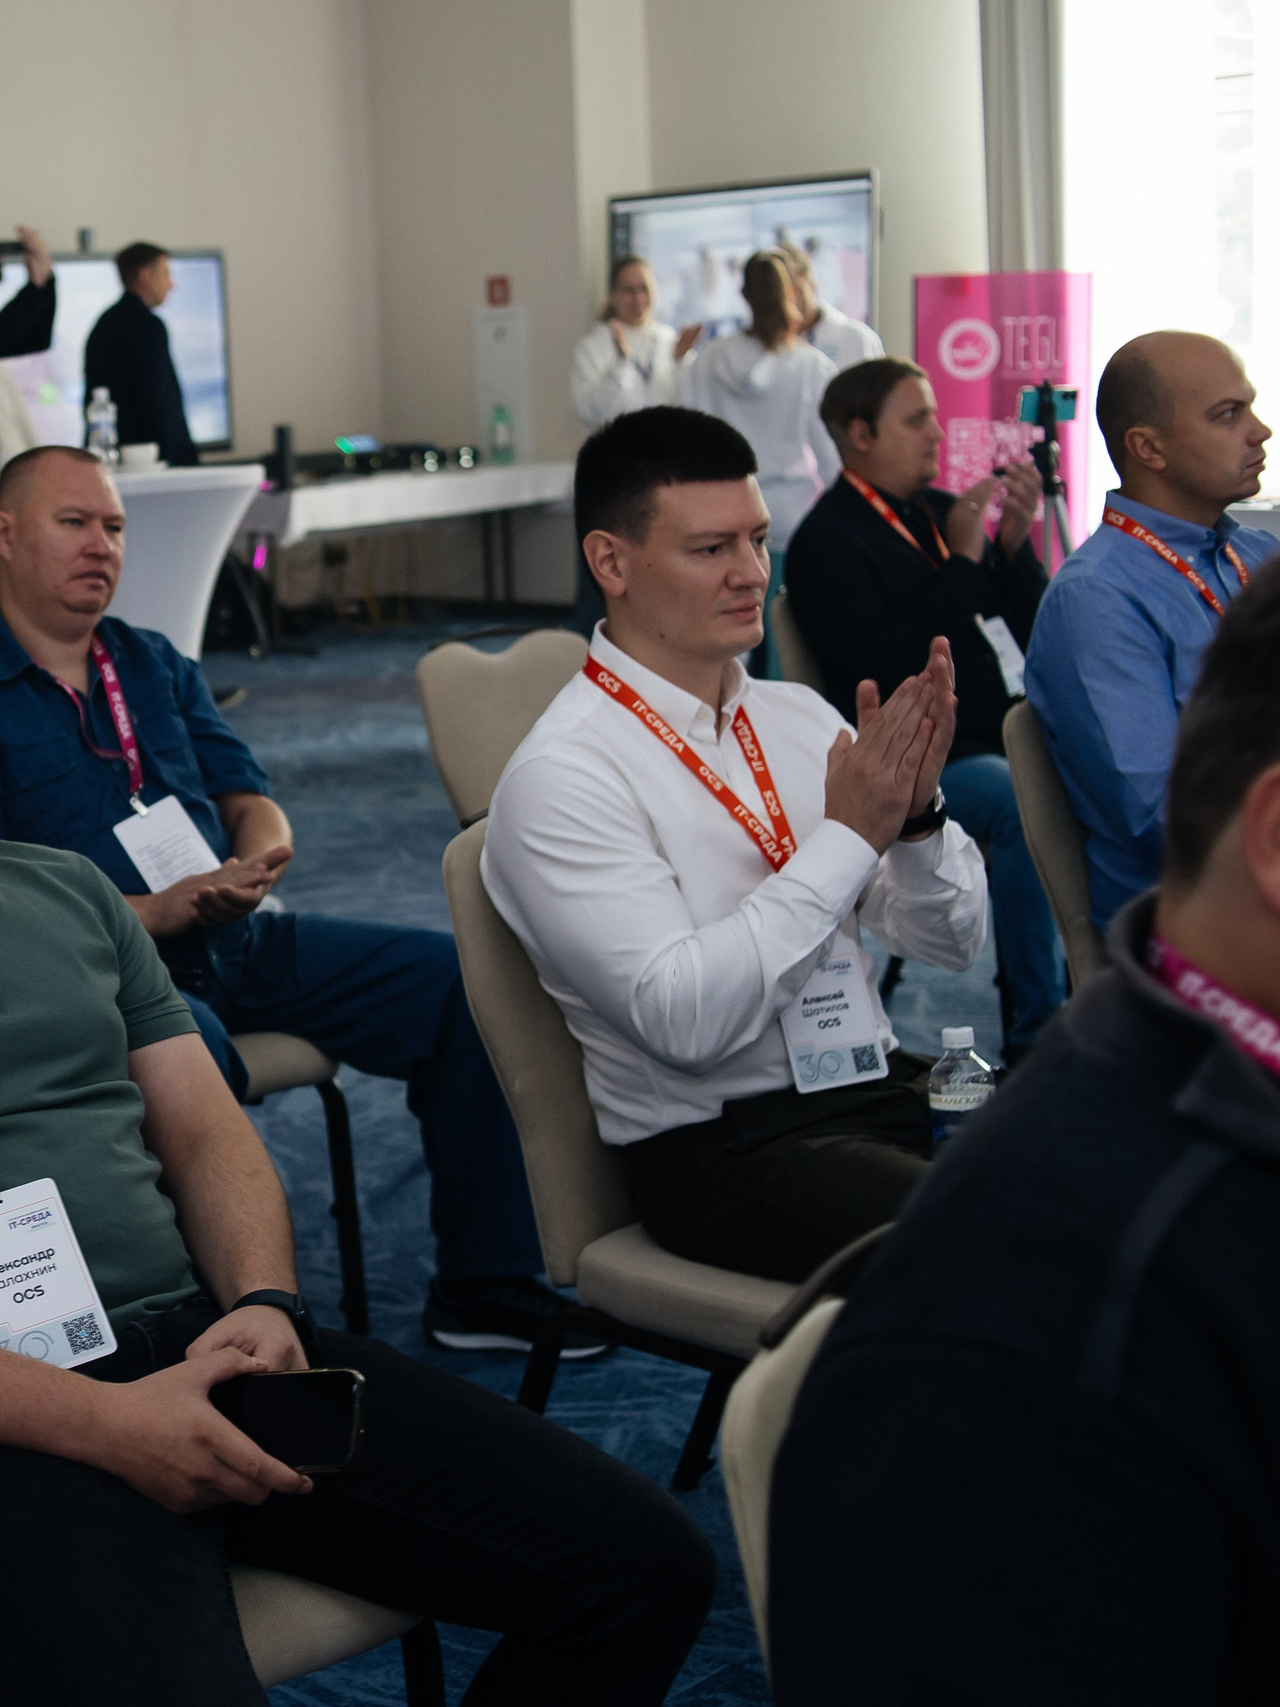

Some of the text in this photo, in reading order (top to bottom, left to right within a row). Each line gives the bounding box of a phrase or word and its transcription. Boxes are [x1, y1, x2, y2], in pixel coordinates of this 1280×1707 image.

[597, 670, 782, 863] OCS IT-СРЕДА OCS IT-СРЕДА
[817, 1016, 842, 1030] OCS
[8, 1210, 53, 1230] IT-СРЕДА
[12, 1284, 45, 1304] OCS
